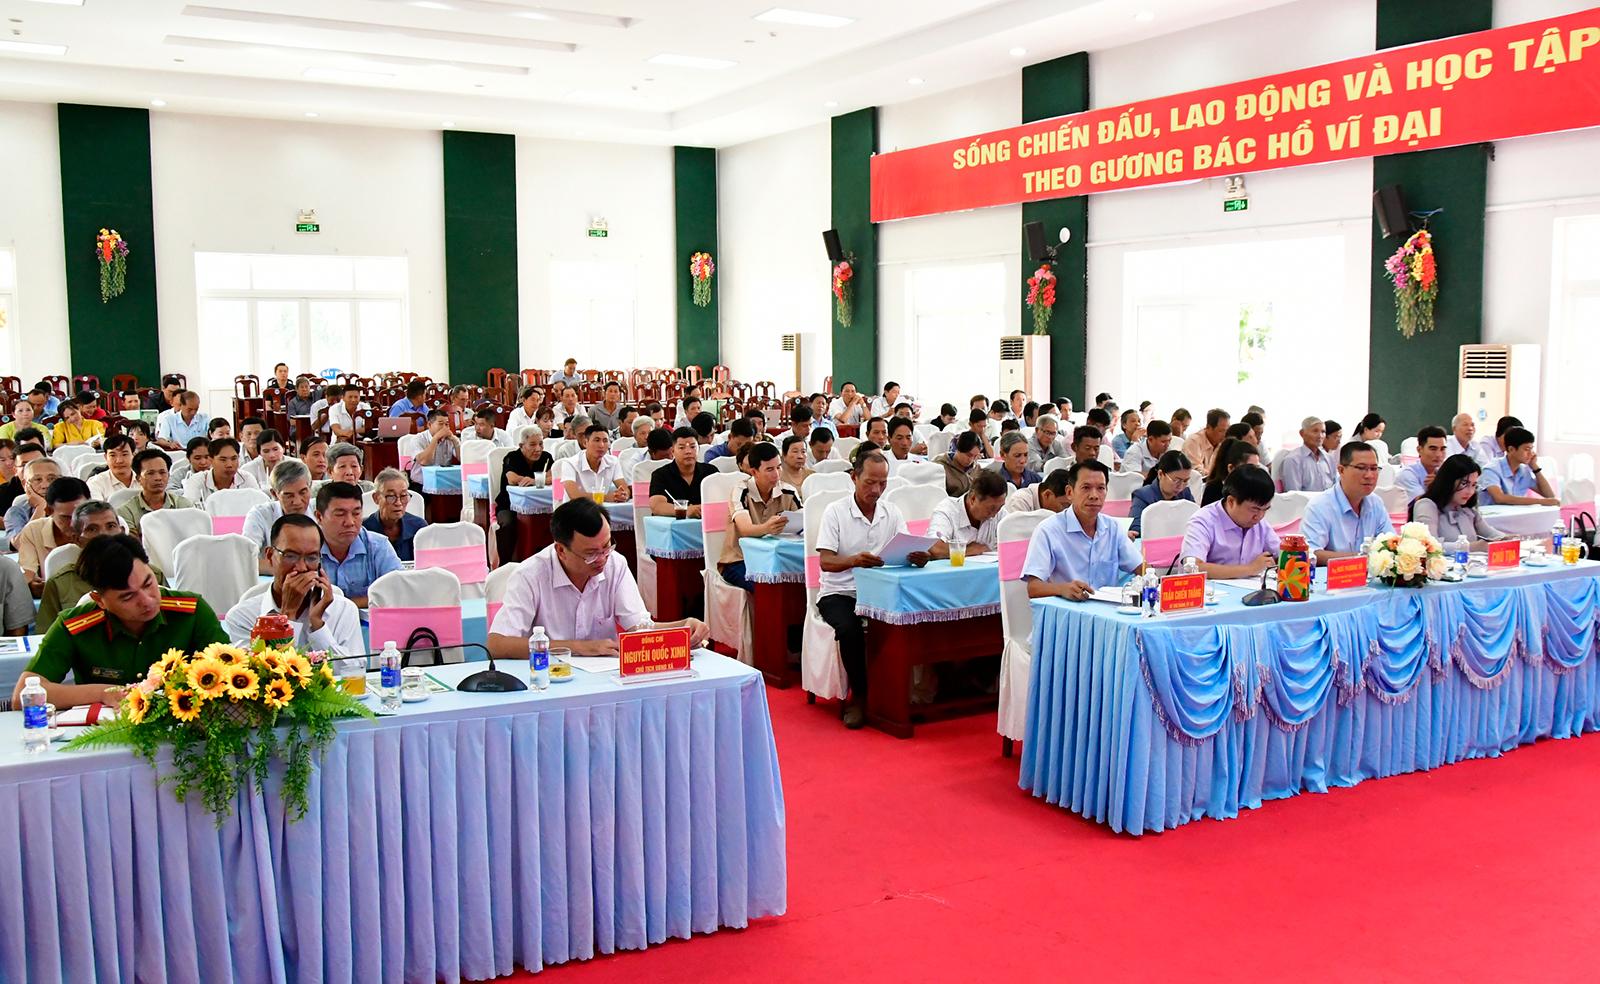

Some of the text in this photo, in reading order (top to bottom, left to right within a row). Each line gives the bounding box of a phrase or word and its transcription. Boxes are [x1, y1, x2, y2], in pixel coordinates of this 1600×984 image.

[953, 27, 1600, 169] SỐNG CHIẾN ĐẤU, LAO ĐỘNG VÀ HỌC TẬP
[1023, 107, 1442, 194] THEO GƯƠNG BÁC HỒ VĨ ĐẠI
[651, 644, 669, 662] QUỐC
[670, 646, 686, 659] XINH
